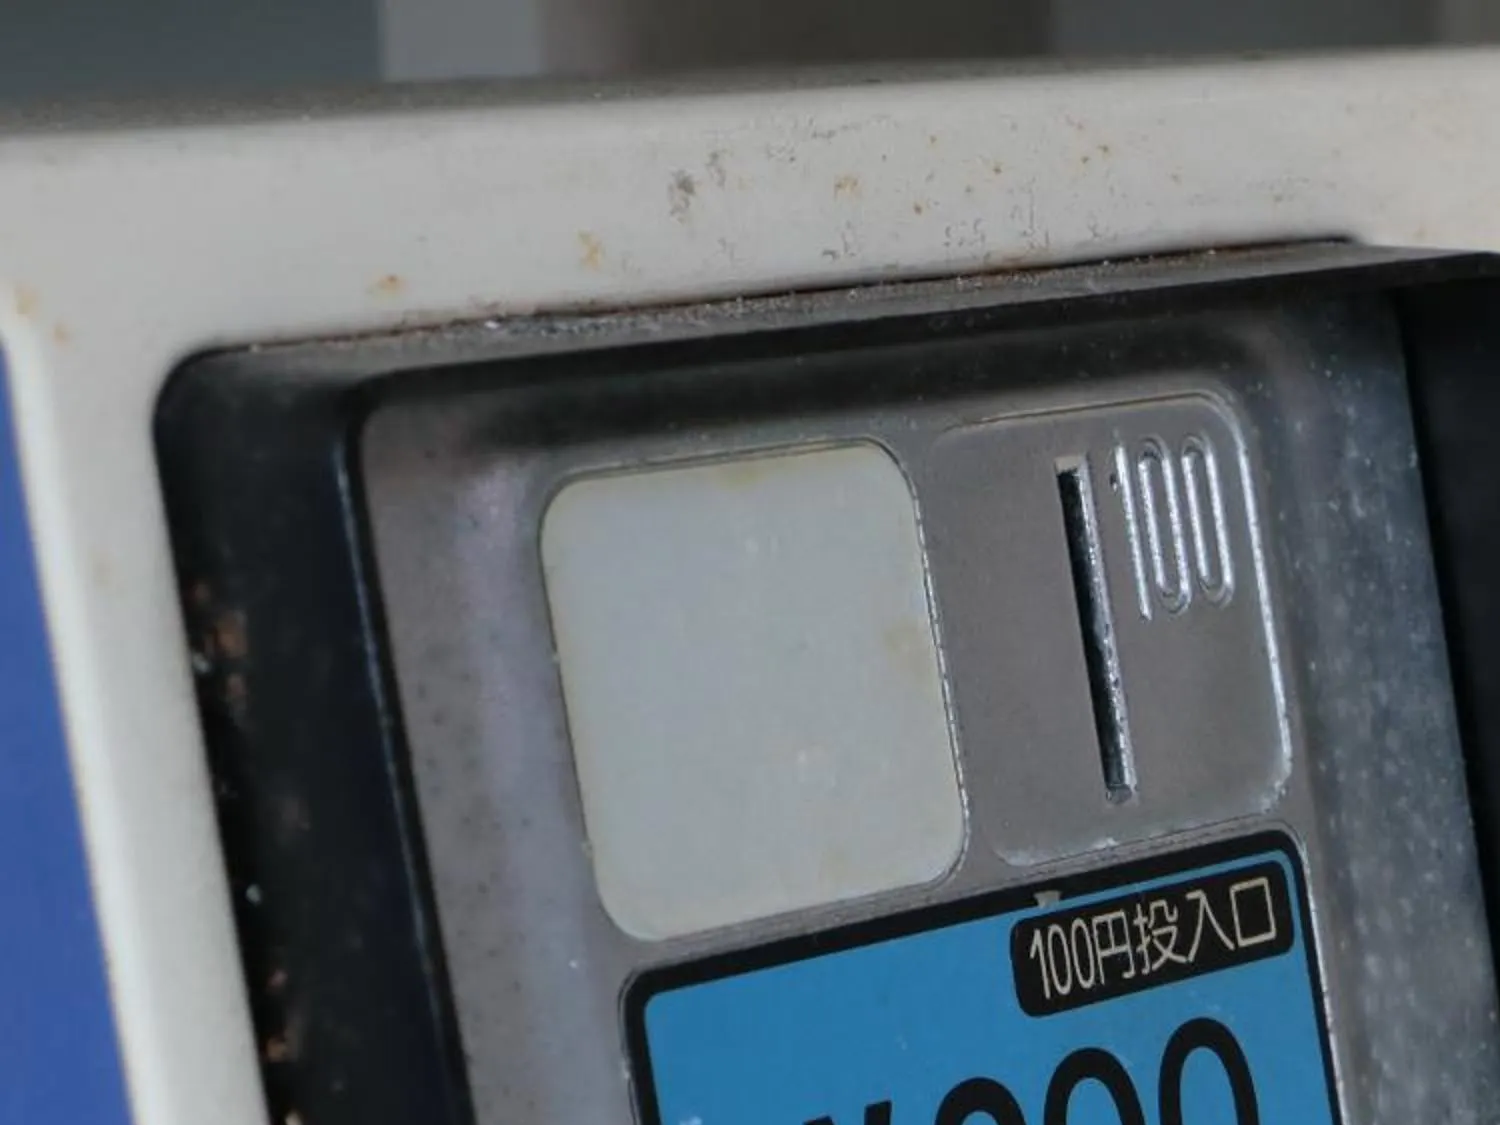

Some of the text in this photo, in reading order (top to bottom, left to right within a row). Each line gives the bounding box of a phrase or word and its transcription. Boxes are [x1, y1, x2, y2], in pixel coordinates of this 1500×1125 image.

[1110, 434, 1234, 620] 100
[1030, 877, 1276, 999] 100円投入口
